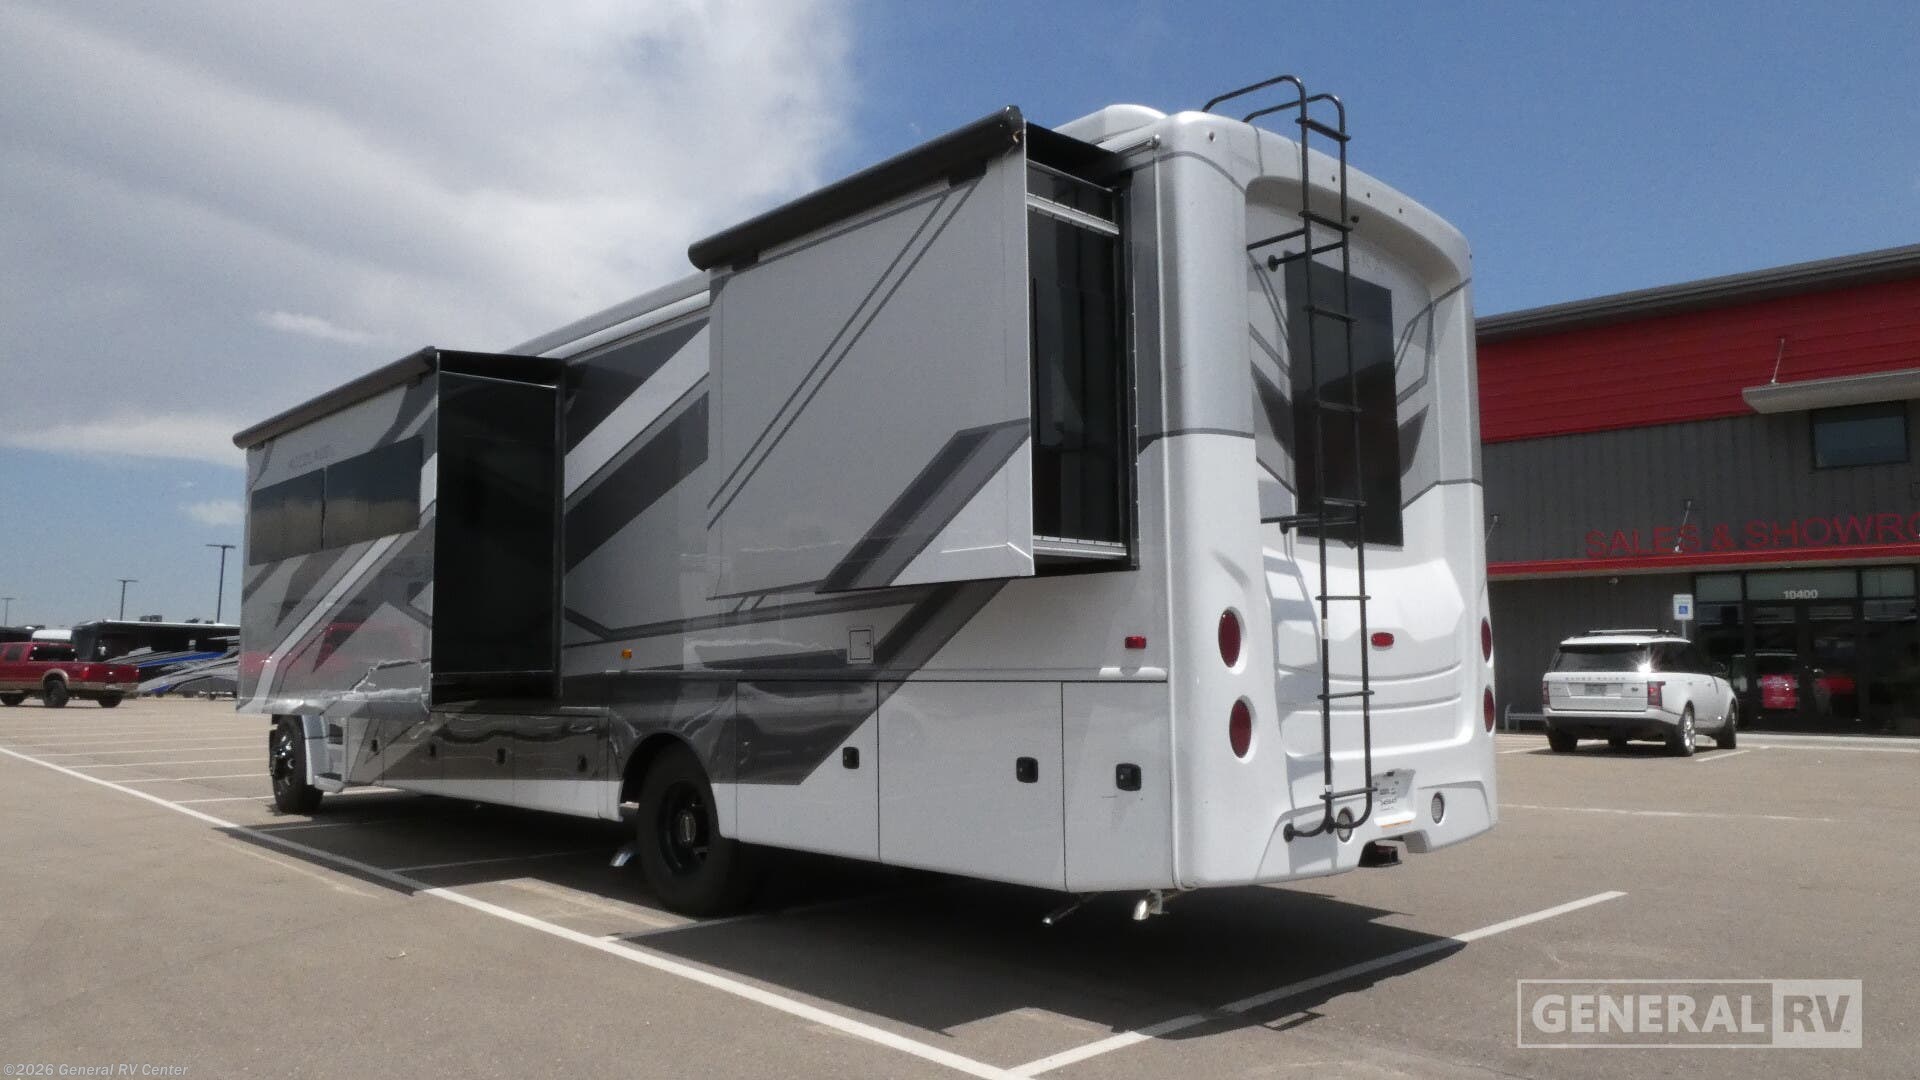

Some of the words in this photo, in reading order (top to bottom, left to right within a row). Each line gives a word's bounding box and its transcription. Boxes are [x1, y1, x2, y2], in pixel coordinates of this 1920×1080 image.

[1584, 523, 1701, 557] SALES
[1711, 522, 1737, 549] &
[1783, 589, 1818, 600] 10400
